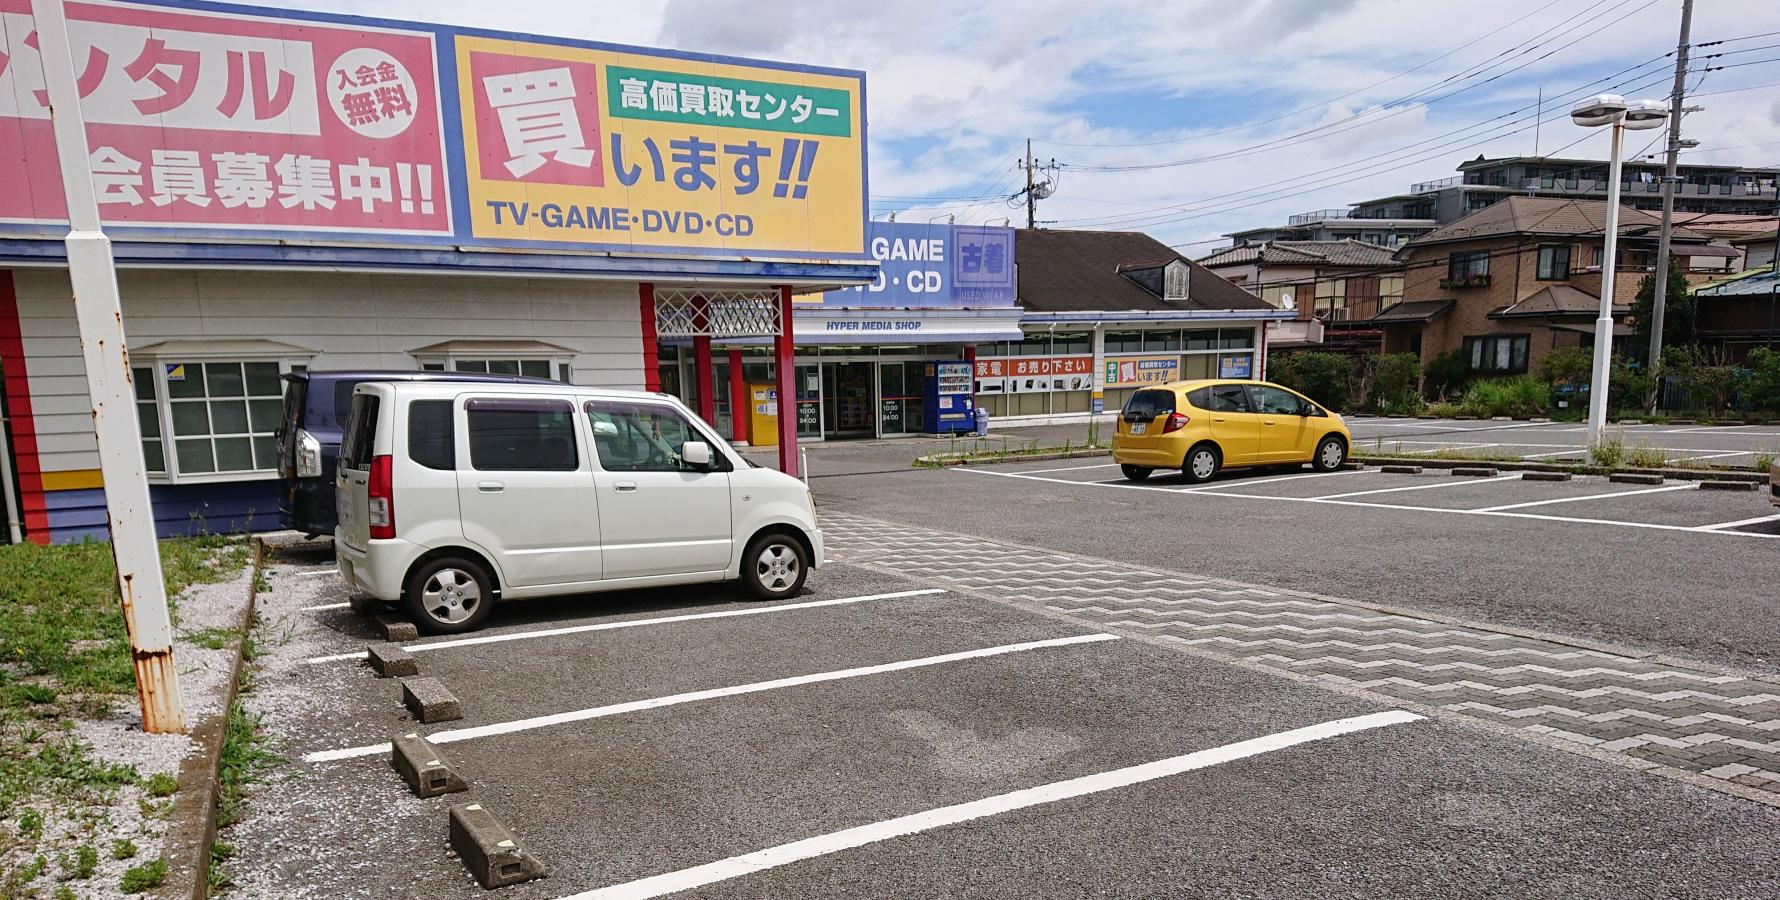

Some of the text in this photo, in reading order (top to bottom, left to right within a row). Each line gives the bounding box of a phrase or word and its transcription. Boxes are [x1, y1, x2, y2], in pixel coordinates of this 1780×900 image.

[0, 30, 296, 121] ンタル
[335, 60, 400, 91] 入会金
[341, 83, 413, 128] 無料
[618, 77, 840, 125] 高価買取センター
[89, 145, 436, 216] 会員募集中!!
[871, 236, 944, 262] GAME
[961, 242, 1004, 274] 古着
[826, 321, 922, 331] HYPER MEDIA SHOP
[976, 359, 1087, 376] 家電 お売り下さい
